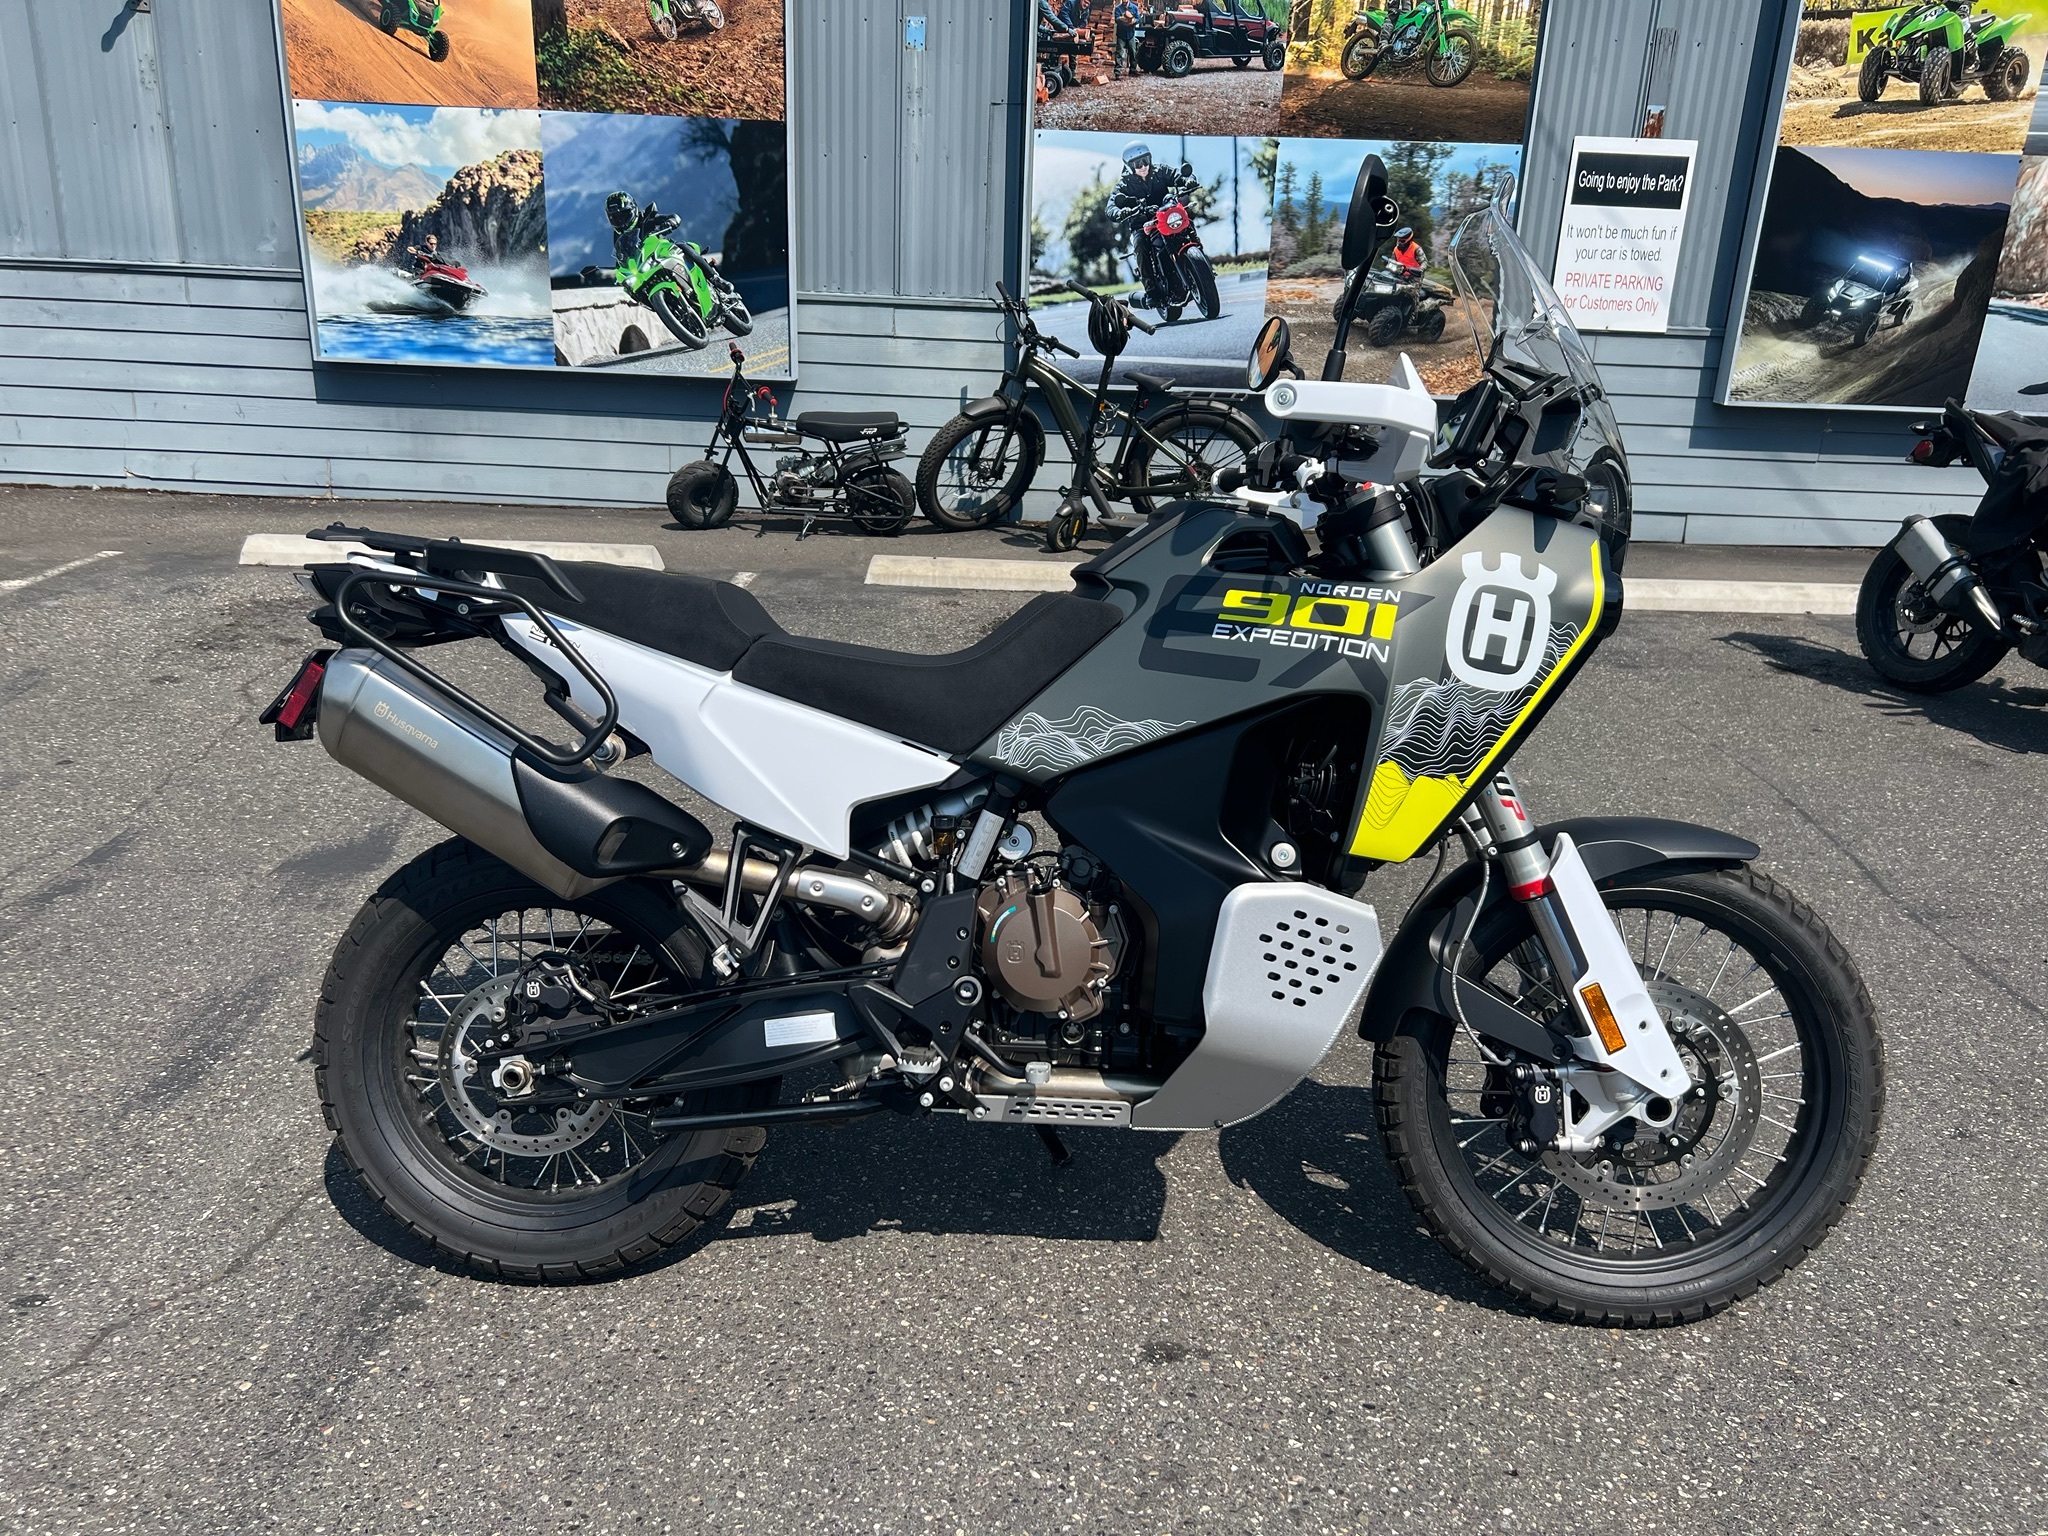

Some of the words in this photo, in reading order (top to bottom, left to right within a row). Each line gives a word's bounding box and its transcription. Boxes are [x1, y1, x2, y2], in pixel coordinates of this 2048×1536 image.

[1578, 170, 1605, 192] Going
[1606, 172, 1615, 189] to
[1616, 172, 1641, 194] enjoy
[1642, 173, 1656, 191] the
[1657, 174, 1684, 192] Park?
[1566, 223, 1574, 238] It
[1576, 224, 1603, 239] won't
[1605, 225, 1618, 239] be
[1620, 226, 1648, 240] much
[1651, 226, 1667, 240] fun
[1669, 226, 1678, 240] if
[1575, 248, 1598, 263] your
[1600, 248, 1617, 260] car
[1619, 246, 1628, 260] is
[1630, 247, 1662, 261] towed.
[1565, 272, 1612, 289] PRIVATE
[1614, 274, 1664, 291] PARKING
[1563, 294, 1577, 309] for
[1580, 294, 1633, 312] Customers
[1635, 297, 1659, 316] Only
[1300, 582, 1402, 602] NORDEN
[1211, 623, 1390, 663] EXPEDITION
[386, 711, 439, 749] Husqvarna
